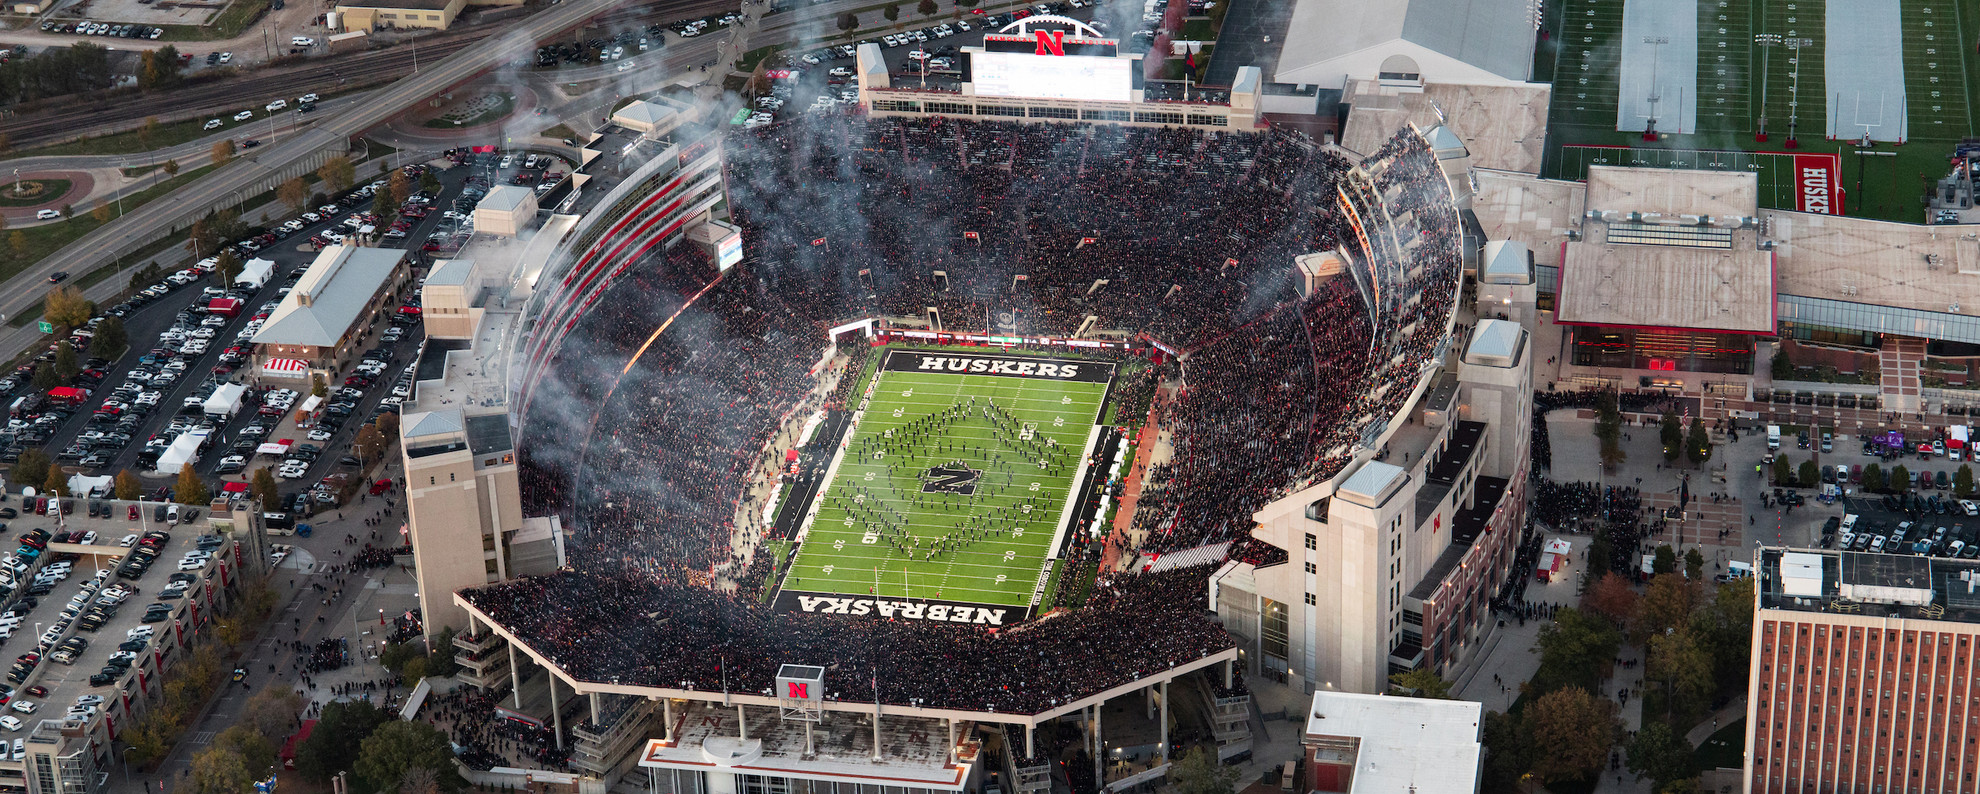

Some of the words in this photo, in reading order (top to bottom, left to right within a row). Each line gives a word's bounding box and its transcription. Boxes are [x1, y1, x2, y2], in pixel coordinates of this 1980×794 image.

[1034, 29, 1065, 56] N
[918, 356, 1079, 378] HUSKERS
[864, 472, 876, 481] 50
[1029, 482, 1041, 492] 50
[1433, 512, 1441, 534] N
[833, 539, 846, 549] 20
[1005, 550, 1016, 560] 20
[797, 596, 1007, 626] NEBRASKA
[788, 682, 808, 699] N
